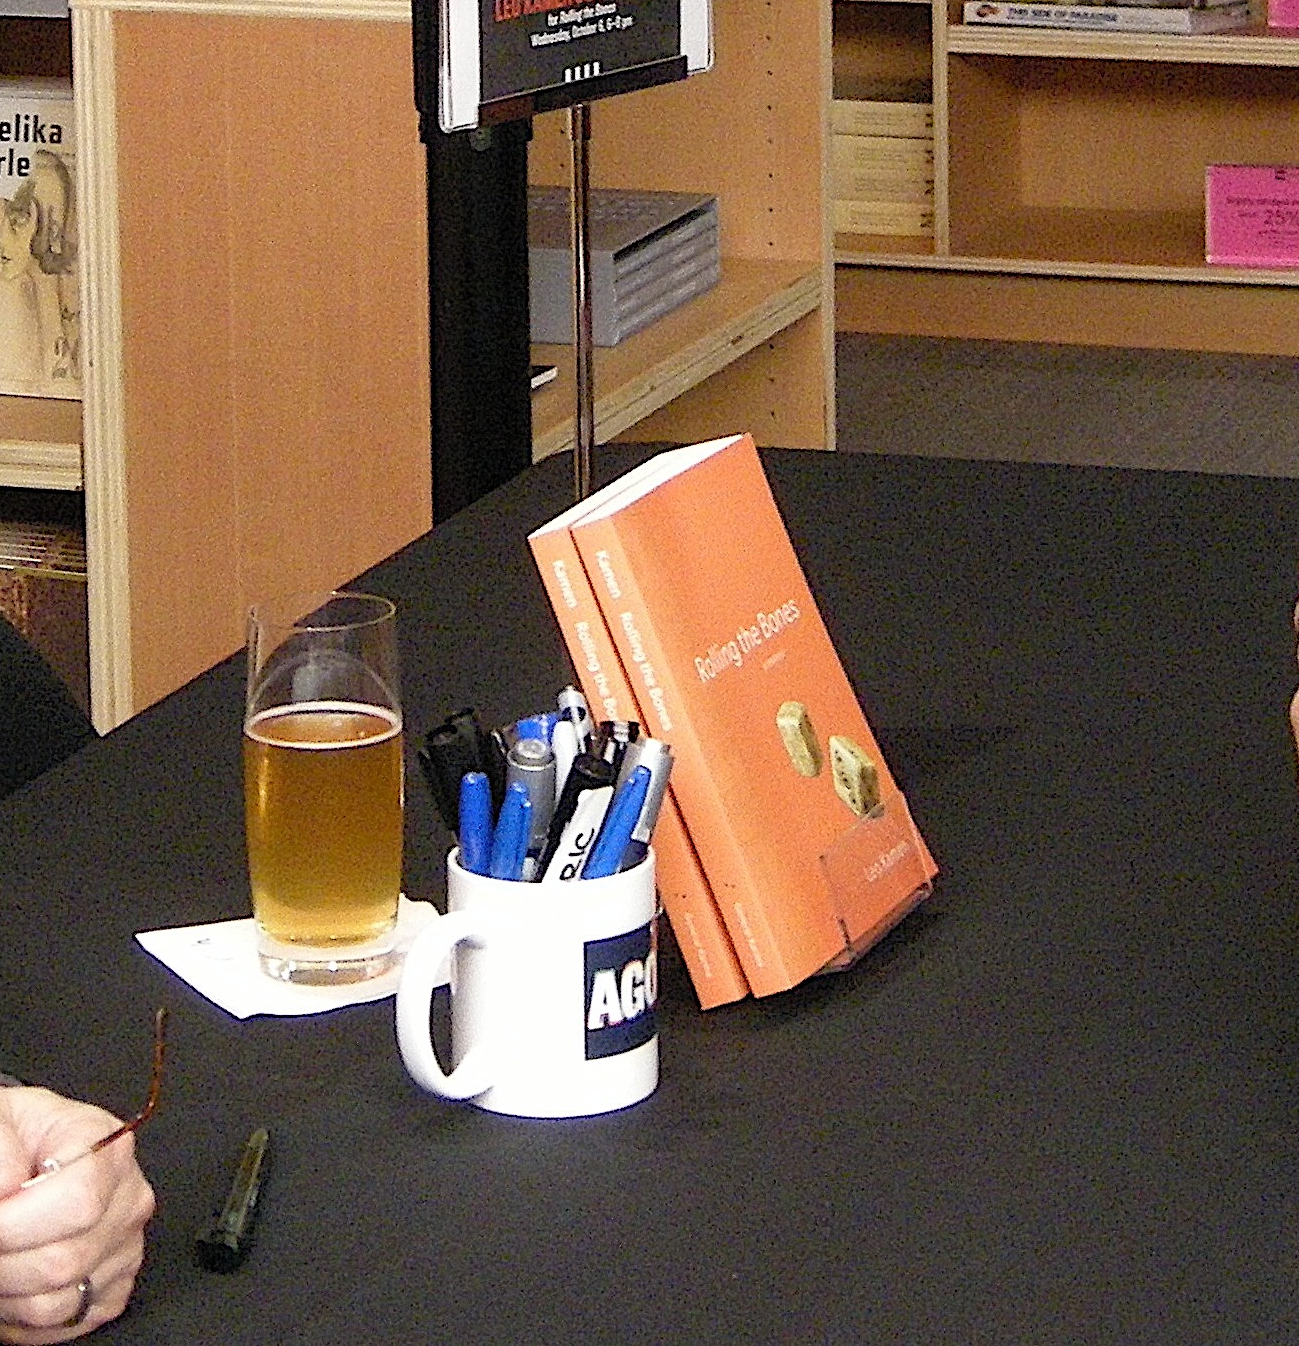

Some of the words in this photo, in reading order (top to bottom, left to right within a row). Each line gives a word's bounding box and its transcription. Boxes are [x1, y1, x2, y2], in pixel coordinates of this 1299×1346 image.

[553, 560, 577, 608] Kamen
[574, 621, 601, 672] Rolling
[596, 550, 621, 600] Kamen
[619, 611, 646, 662] Rolling
[638, 662, 656, 687] the
[648, 687, 673, 732] Bones
[694, 637, 745, 685] Rolling
[735, 624, 762, 654] the
[757, 598, 803, 638] Bones
